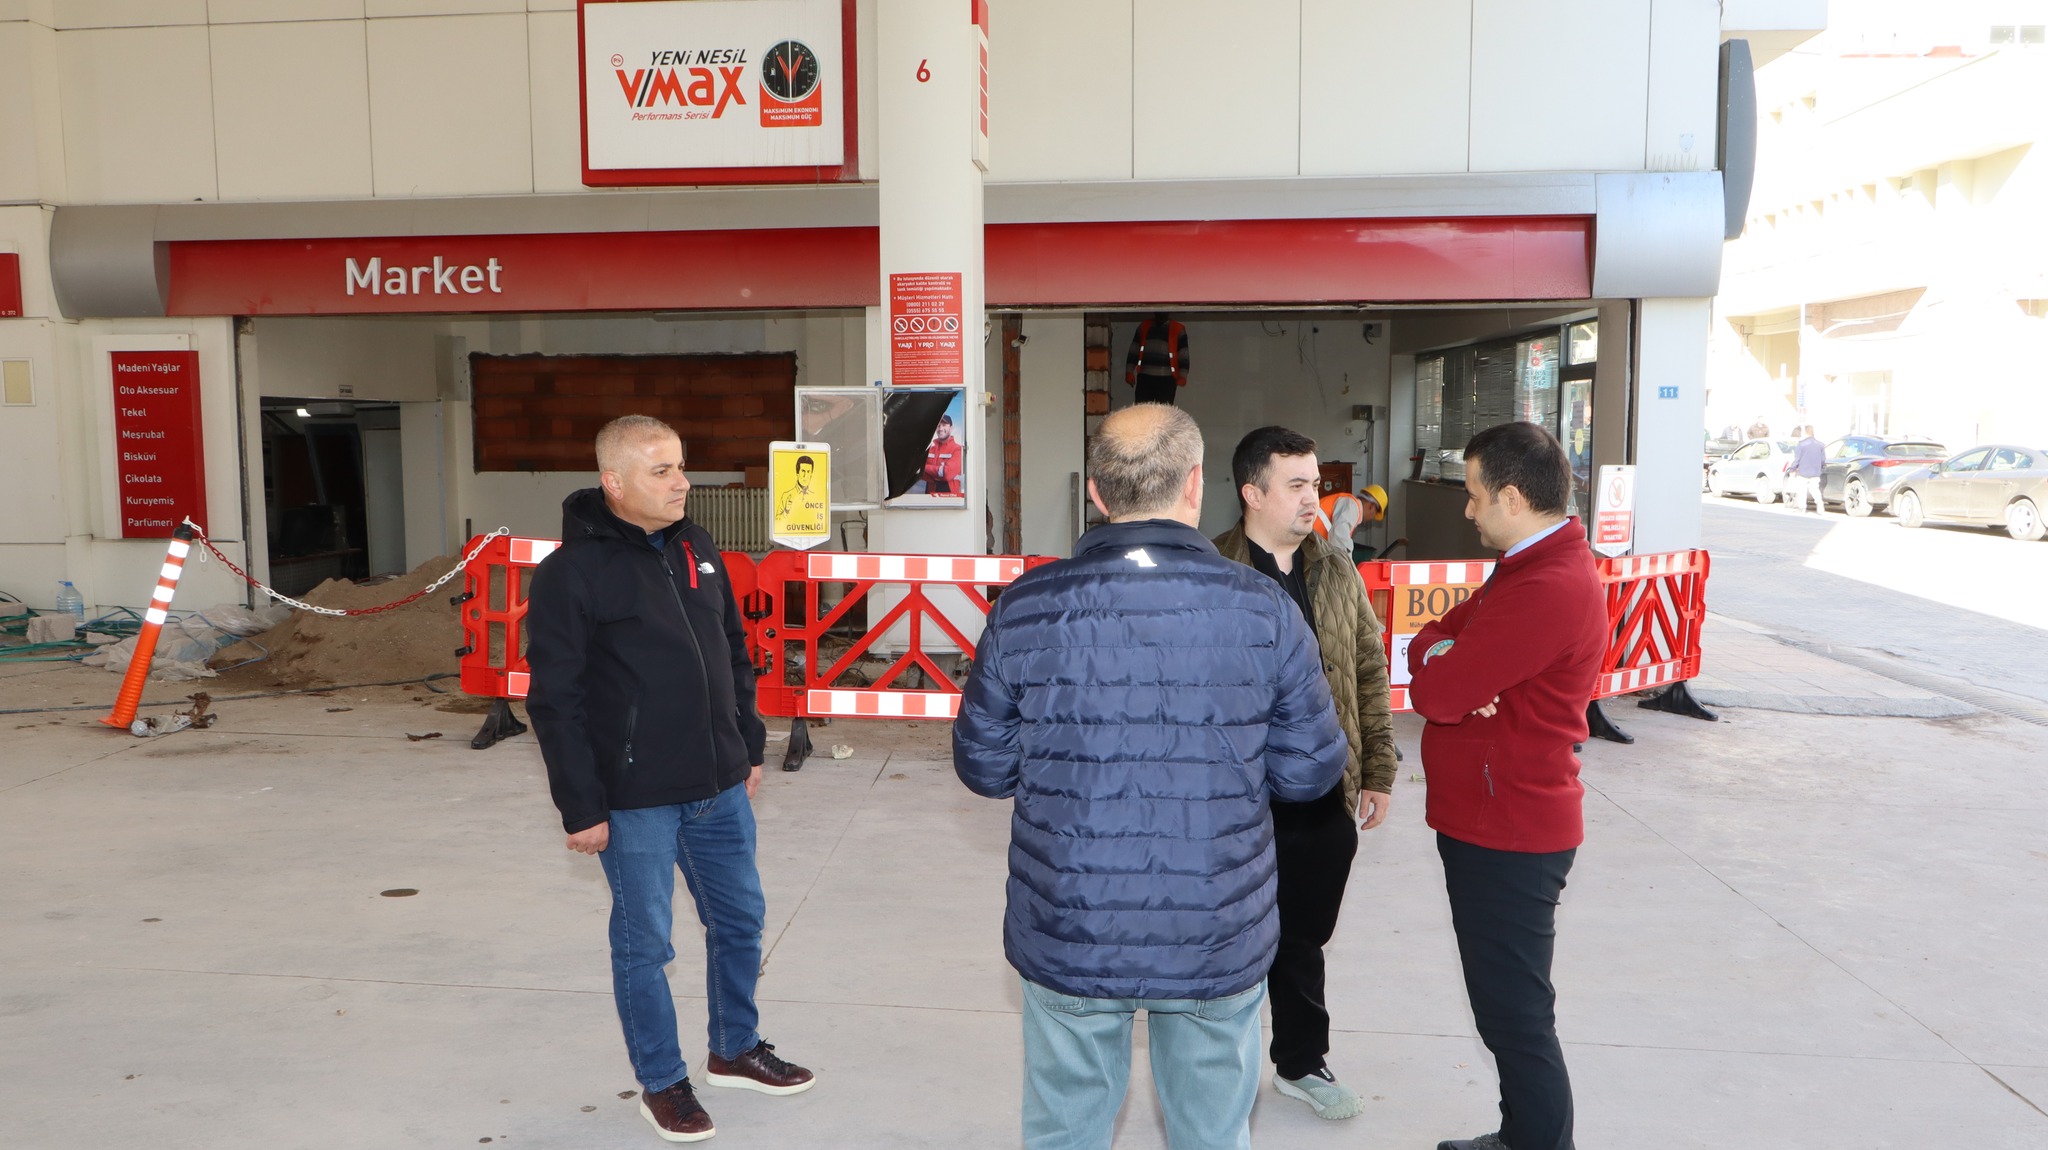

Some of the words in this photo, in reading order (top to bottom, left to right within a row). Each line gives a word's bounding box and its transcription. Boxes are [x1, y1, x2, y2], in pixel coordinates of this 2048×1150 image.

[916, 59, 931, 83] 6
[632, 112, 683, 121] Performans
[684, 111, 710, 119] Serisi
[345, 255, 502, 296] Market
[118, 364, 150, 372] Madeni
[152, 363, 181, 374] Yağlar
[120, 386, 135, 394] Oto
[137, 386, 179, 395] Aksesuar
[1664, 388, 1674, 397] 11
[121, 408, 147, 417] Tekel
[122, 430, 165, 439] Meşrubat
[124, 452, 157, 461] Bisküvi
[125, 474, 162, 483] Çikolata
[126, 496, 175, 506] Kuruyemiş
[805, 500, 824, 509] ÖNCE
[816, 513, 824, 521] İŞ
[127, 517, 173, 527] Parfümeri
[786, 522, 824, 531] GÜVENLİĞİ
